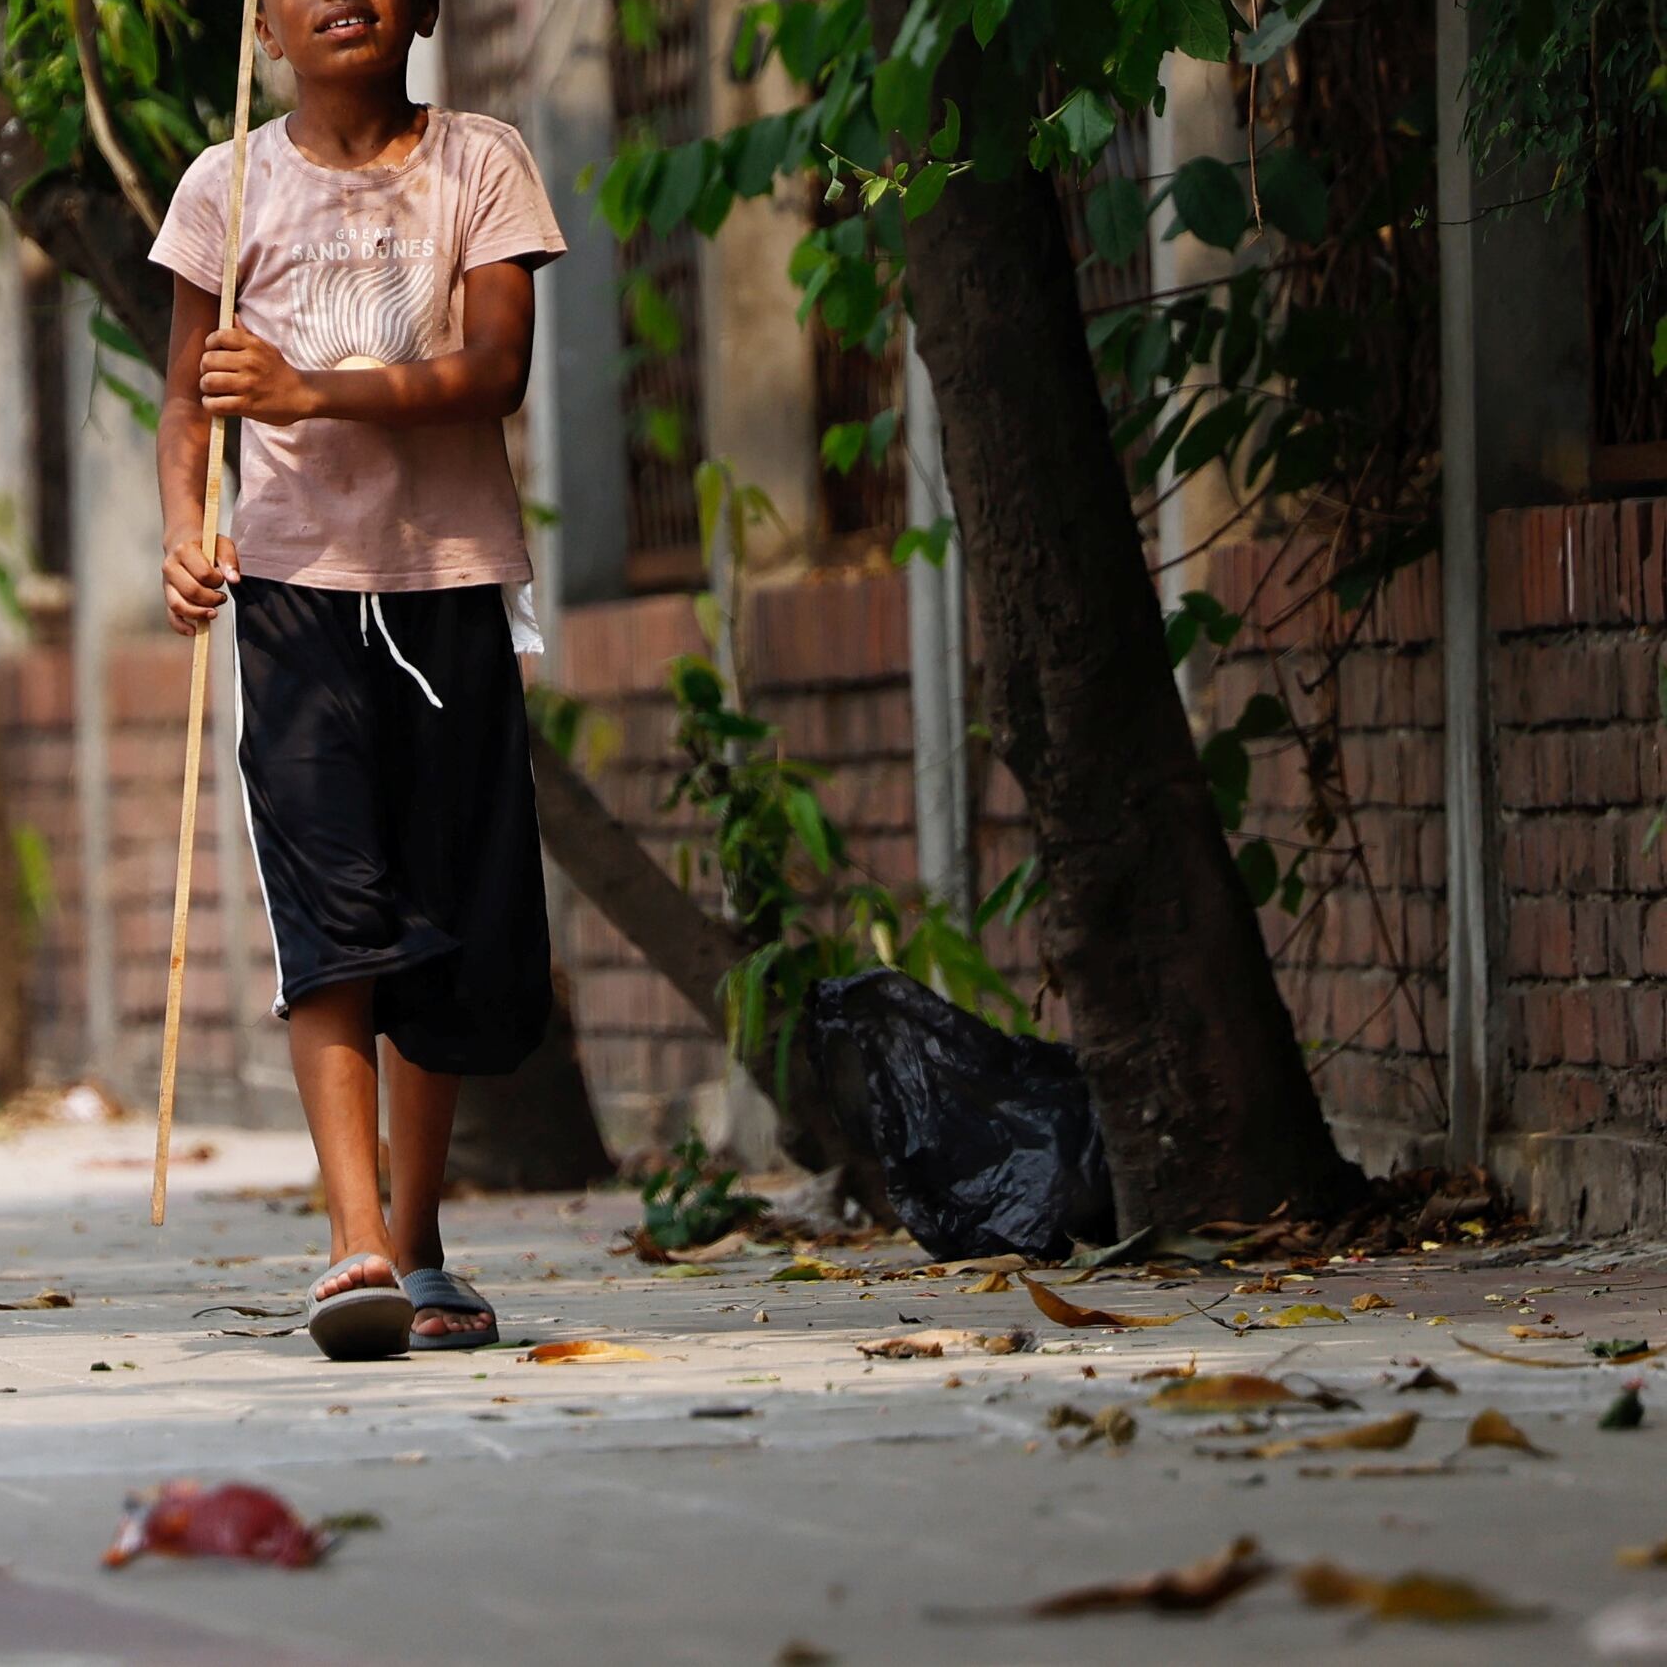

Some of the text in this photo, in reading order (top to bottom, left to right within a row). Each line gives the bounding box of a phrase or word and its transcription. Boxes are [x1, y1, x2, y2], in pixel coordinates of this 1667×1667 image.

[335, 227, 393, 240] GREAT
[291, 238, 434, 262] SAND DUNES
